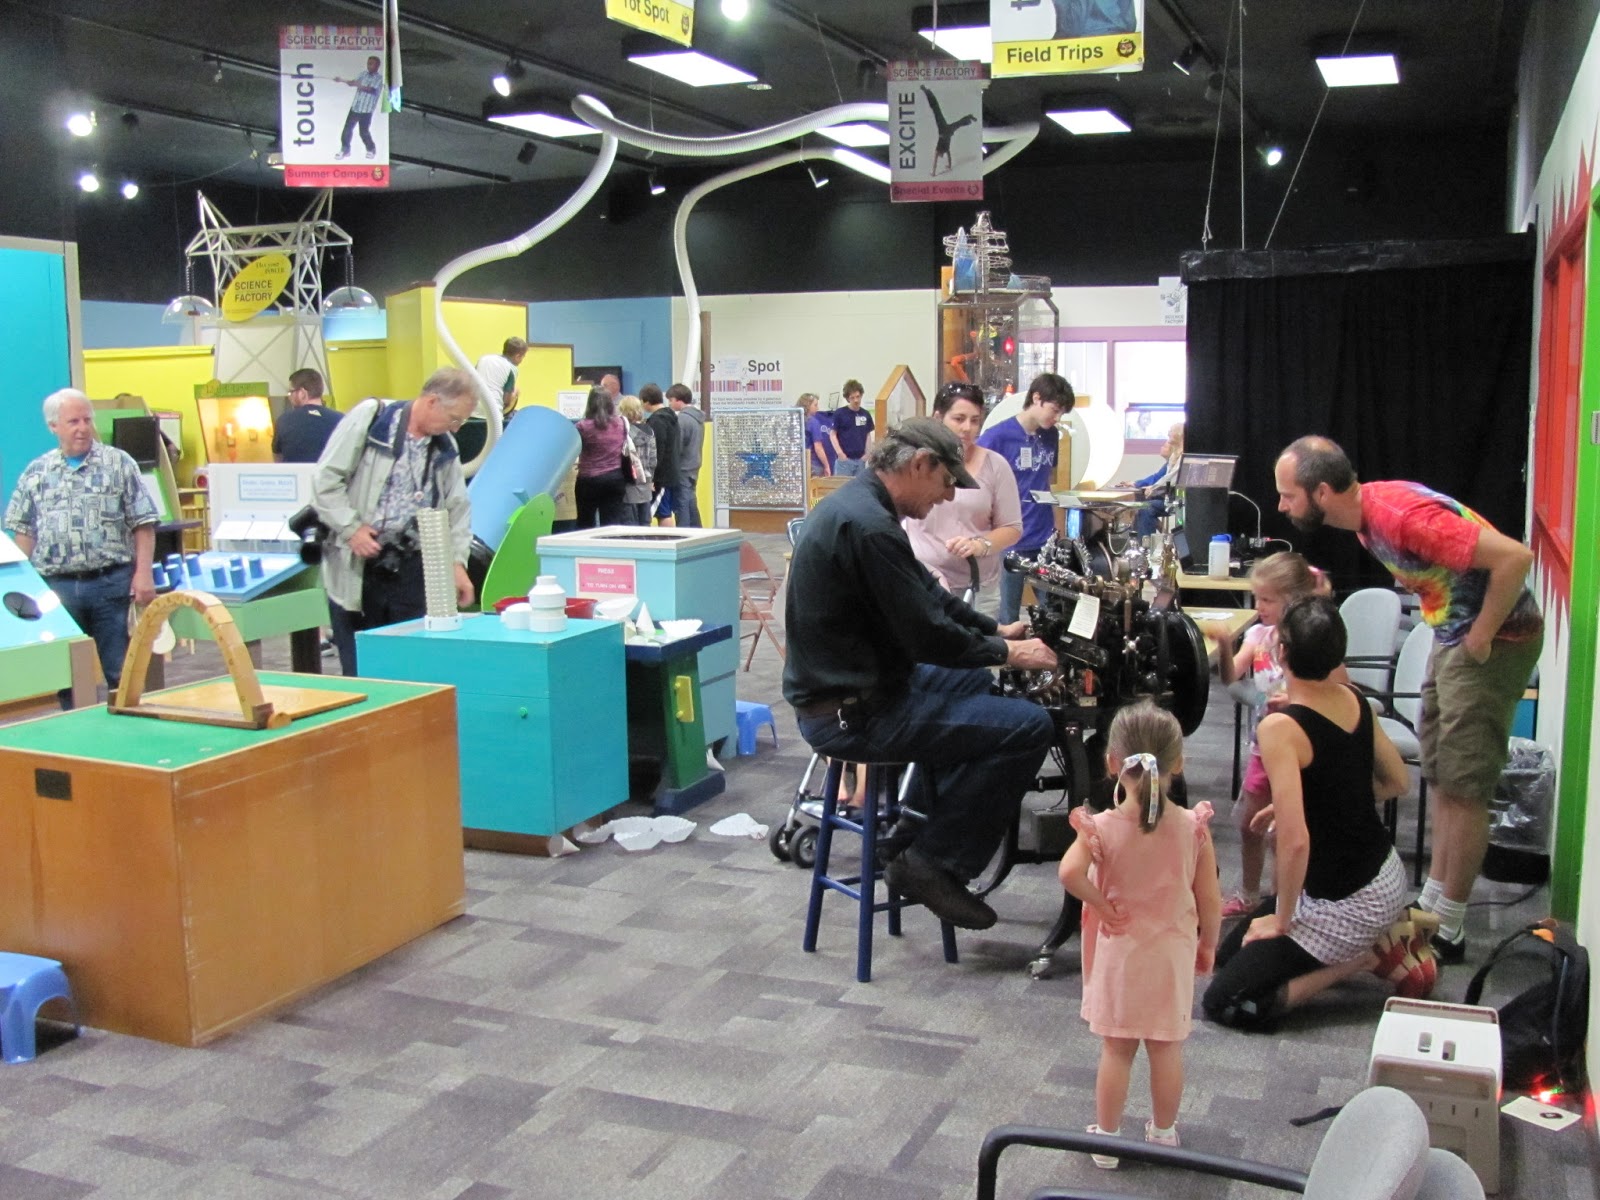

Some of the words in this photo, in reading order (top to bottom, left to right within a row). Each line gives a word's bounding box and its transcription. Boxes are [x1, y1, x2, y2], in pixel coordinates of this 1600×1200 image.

[644, 0, 670, 23] Spot
[287, 35, 331, 46] SCIENCE
[333, 35, 382, 46] FACTORY
[1007, 46, 1051, 64] Field
[1057, 44, 1103, 64] Trips
[893, 68, 932, 77] SCIENCE
[934, 67, 976, 77] FACTORY
[291, 62, 315, 147] touch
[898, 92, 915, 170] EXCITE
[287, 168, 330, 178] Summer
[894, 185, 930, 196] Special
[932, 185, 966, 195] Events
[234, 280, 273, 291] SCIENCE
[234, 292, 273, 303] FACTORY
[748, 360, 781, 375] Spot
